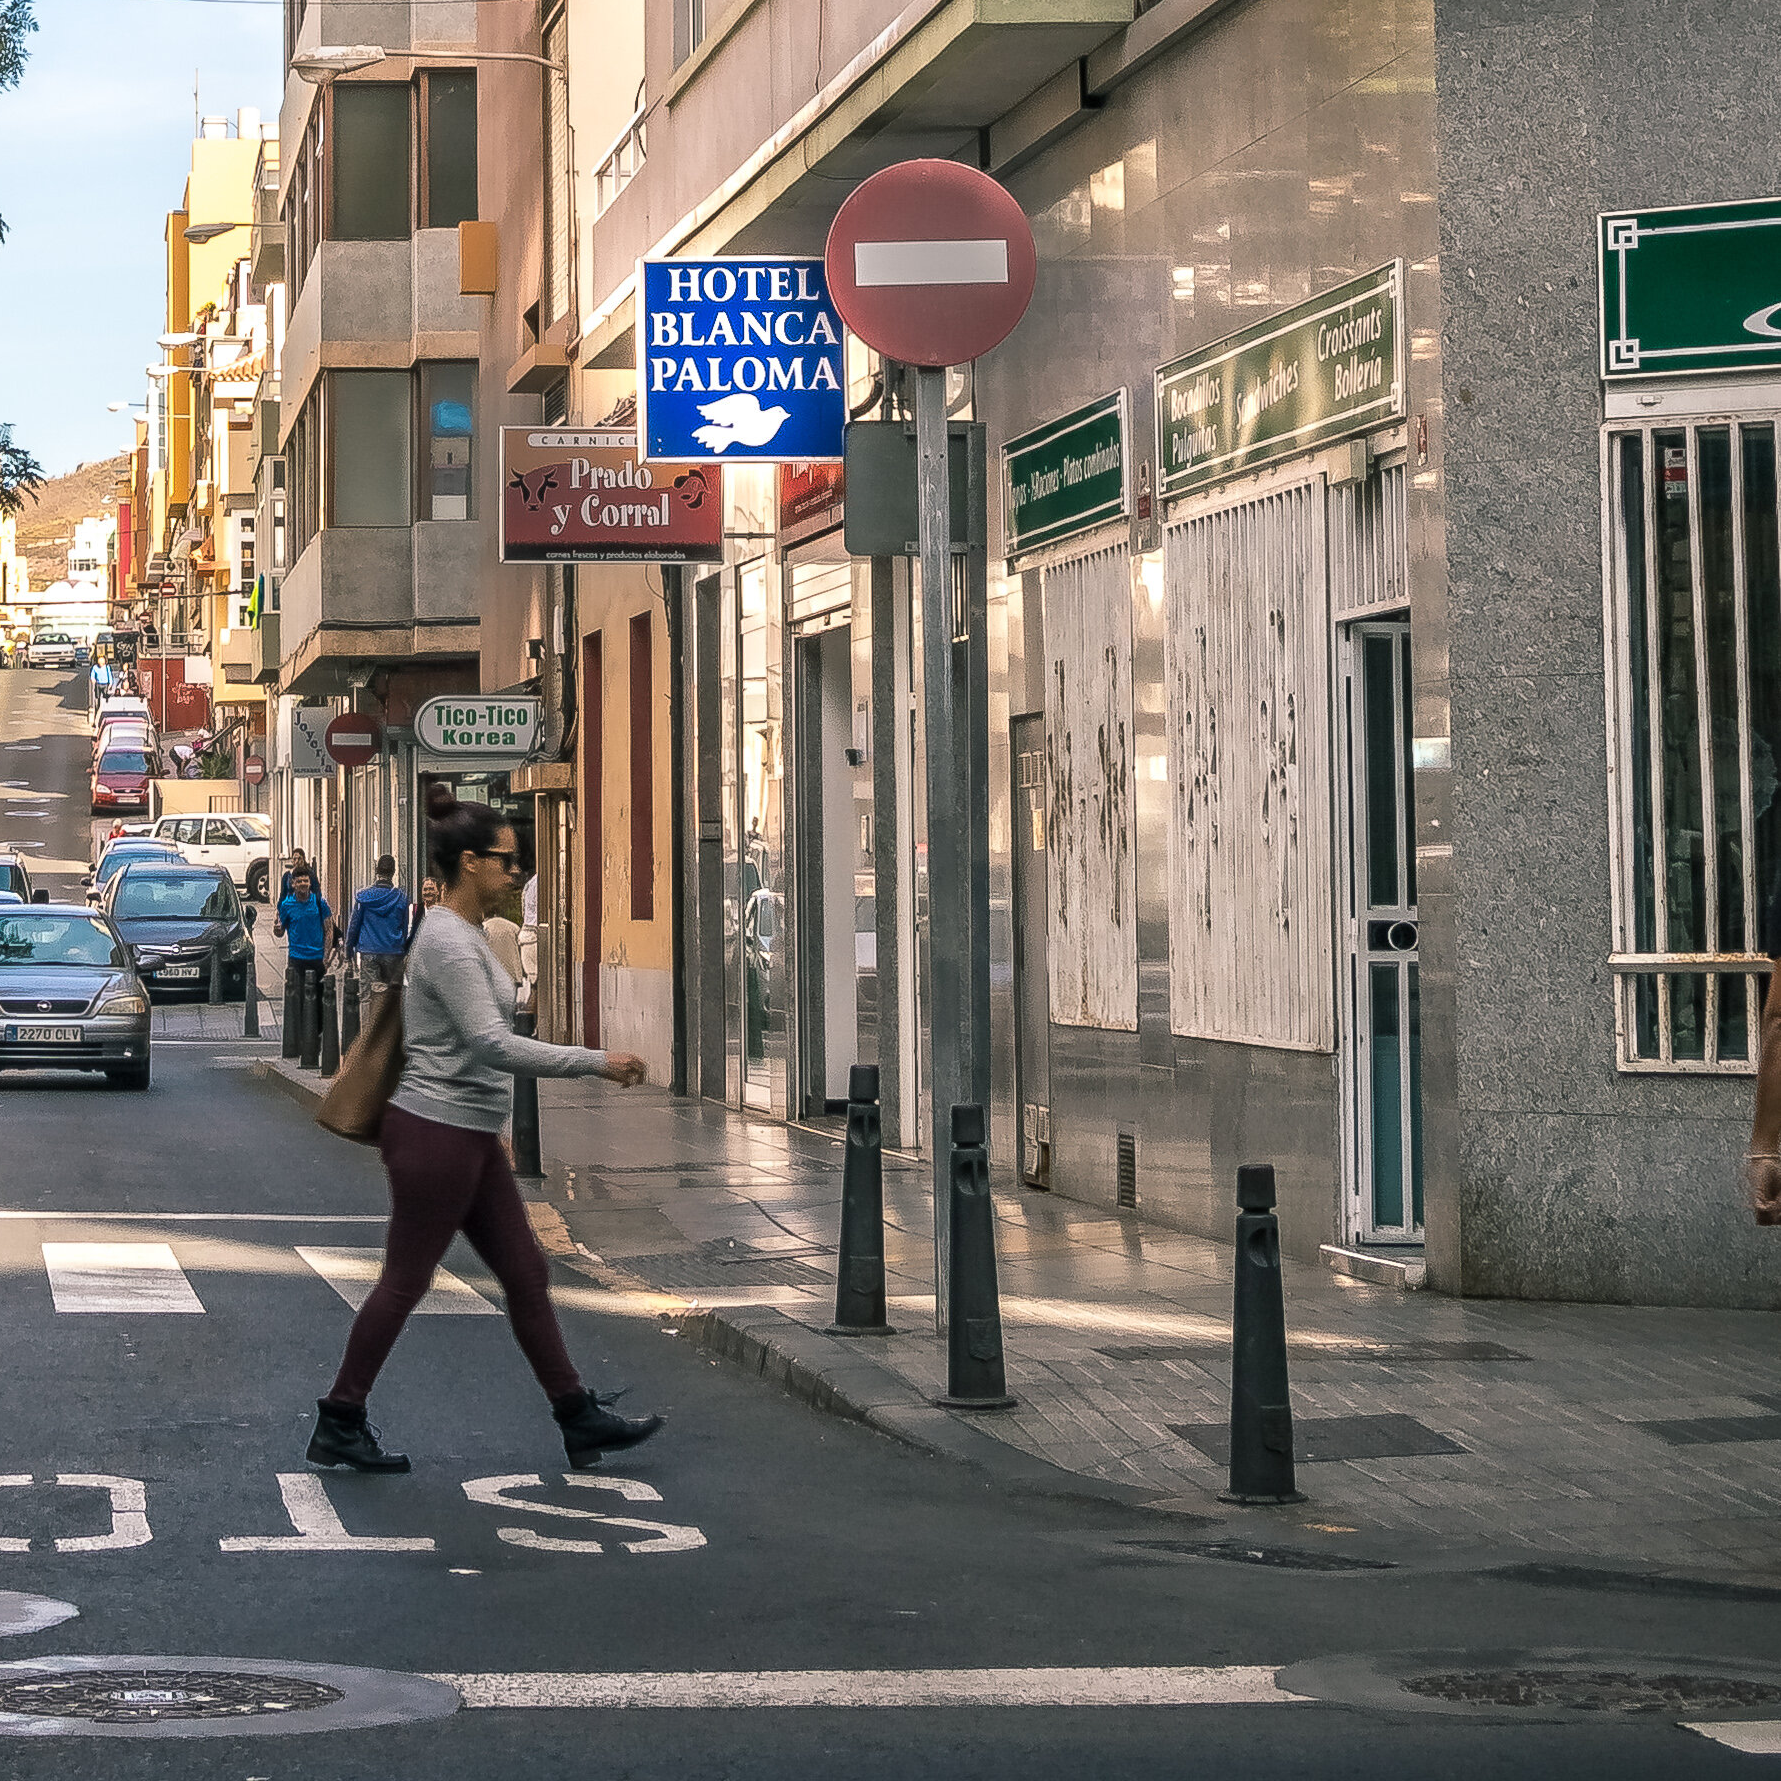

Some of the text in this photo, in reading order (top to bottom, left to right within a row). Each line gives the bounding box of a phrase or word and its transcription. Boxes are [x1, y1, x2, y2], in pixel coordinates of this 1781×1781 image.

[668, 267, 819, 302] HOTEL
[651, 311, 840, 346] BLANCA
[1318, 306, 1382, 362] Croissants
[650, 356, 841, 392] PALOMA
[1334, 347, 1382, 402] Bollería
[1171, 372, 1221, 423] Bocadillos
[1235, 358, 1299, 431] Sandwiches
[1172, 422, 1218, 470] Pulguitas
[567, 457, 653, 490] Prado
[550, 493, 670, 535] y Corral
[434, 705, 528, 727] Tico-Tico
[442, 729, 516, 746] Korea
[19, 1028, 79, 1040] 2270 CLV
